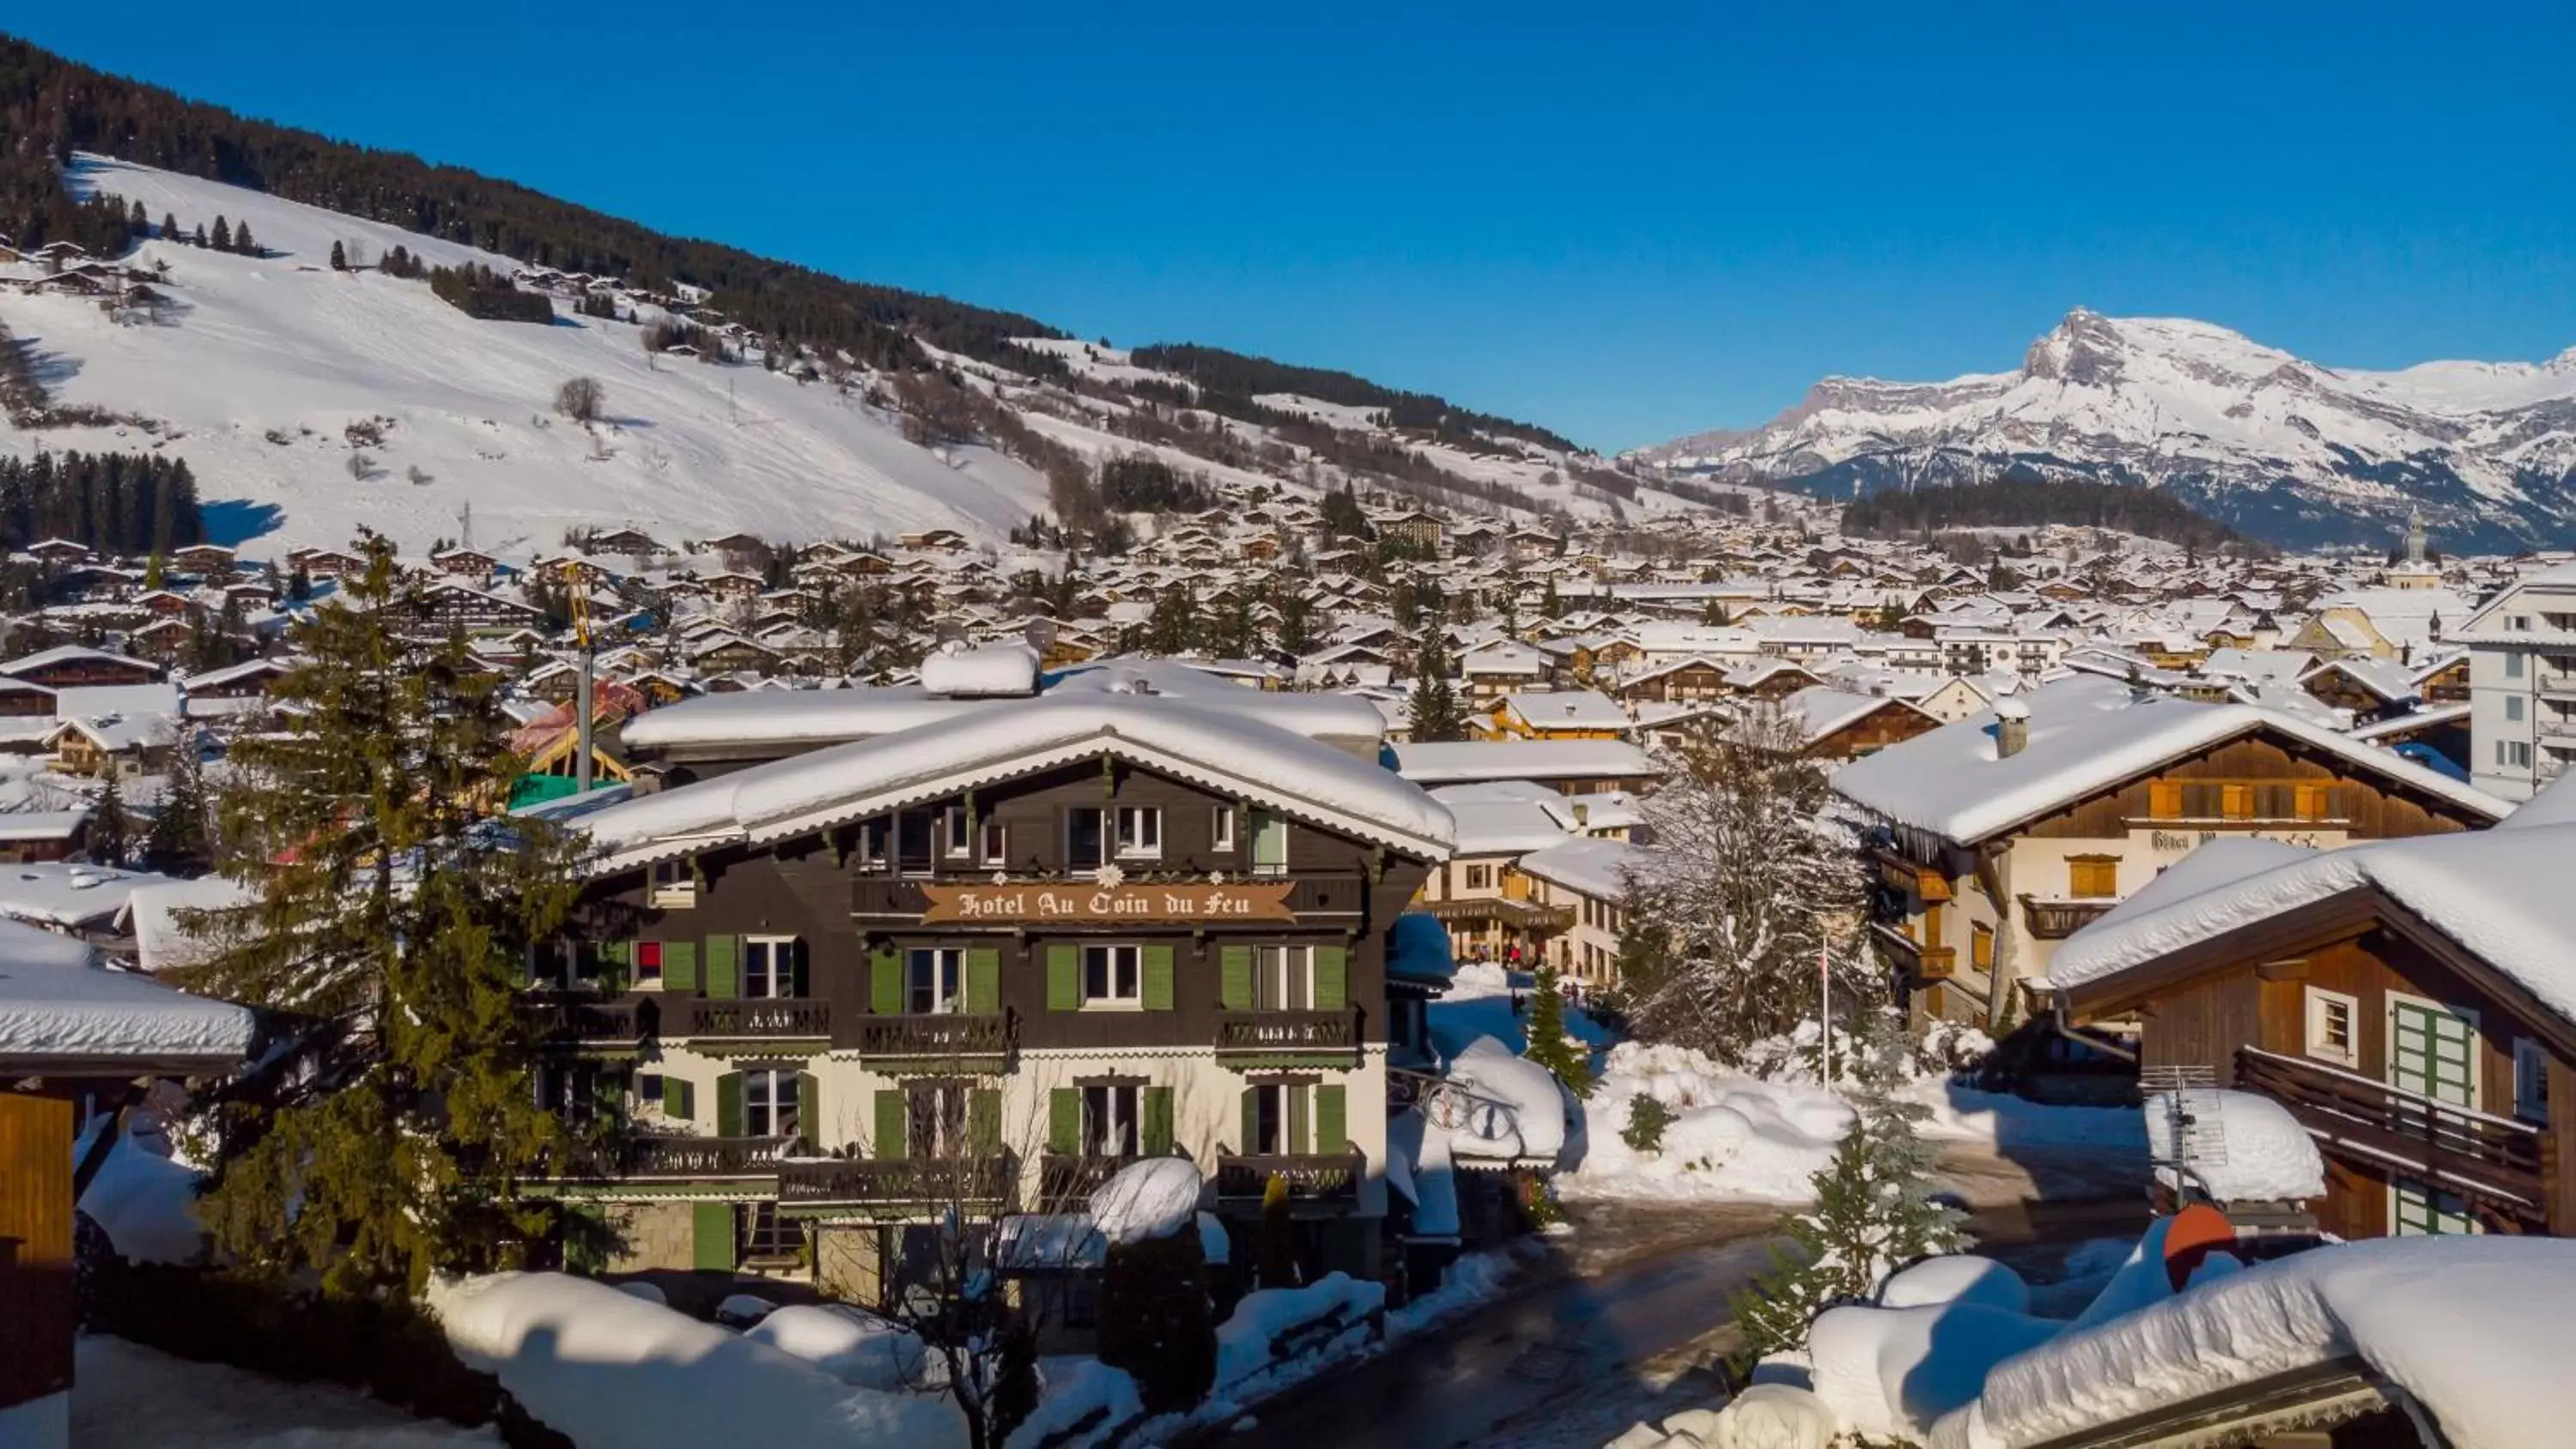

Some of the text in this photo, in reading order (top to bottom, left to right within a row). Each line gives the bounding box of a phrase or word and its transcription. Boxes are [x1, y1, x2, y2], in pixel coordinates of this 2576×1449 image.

[958, 891, 1250, 917] Hotel Au Coin du Feu
